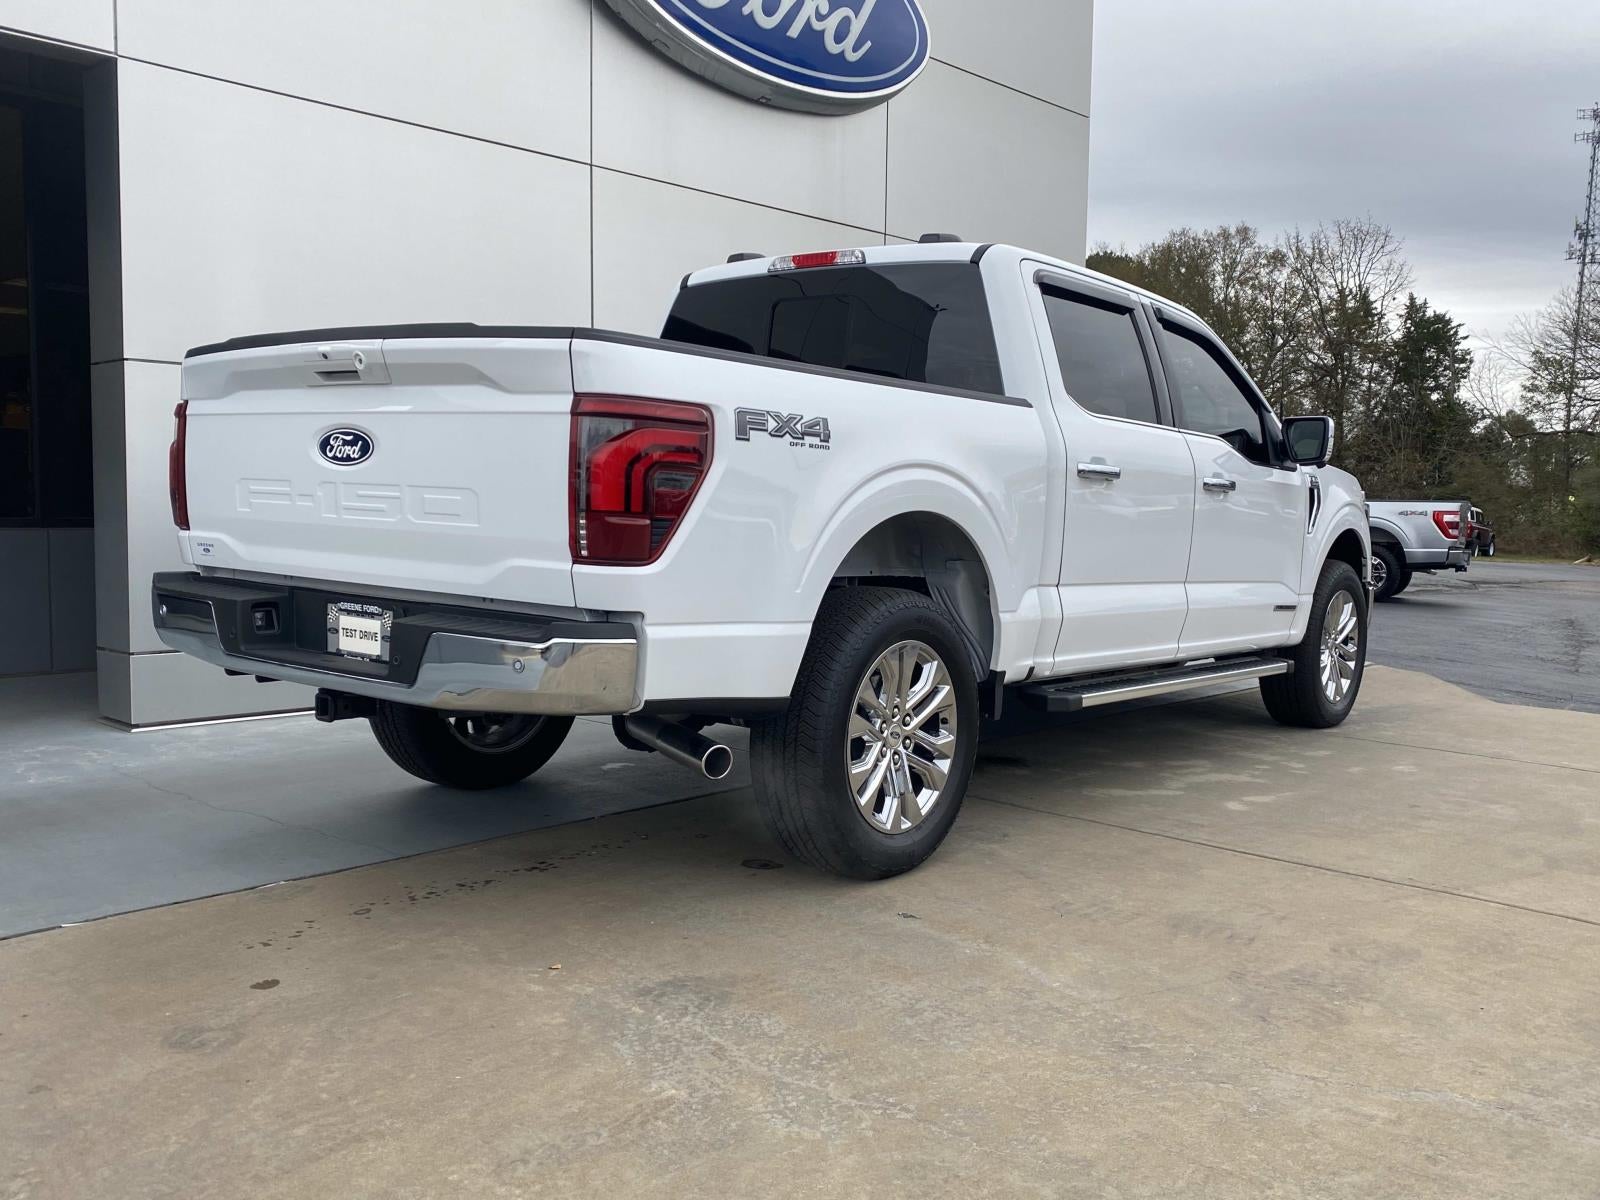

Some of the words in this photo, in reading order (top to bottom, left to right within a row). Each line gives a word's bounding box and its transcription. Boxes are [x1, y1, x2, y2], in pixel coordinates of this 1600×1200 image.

[696, 0, 877, 62] ord
[734, 407, 831, 443] FX4
[326, 433, 362, 459] Ford
[339, 602, 363, 611] GREENE
[363, 605, 379, 614] FORD
[341, 627, 357, 638] TEST
[359, 630, 379, 641] DRIVE
